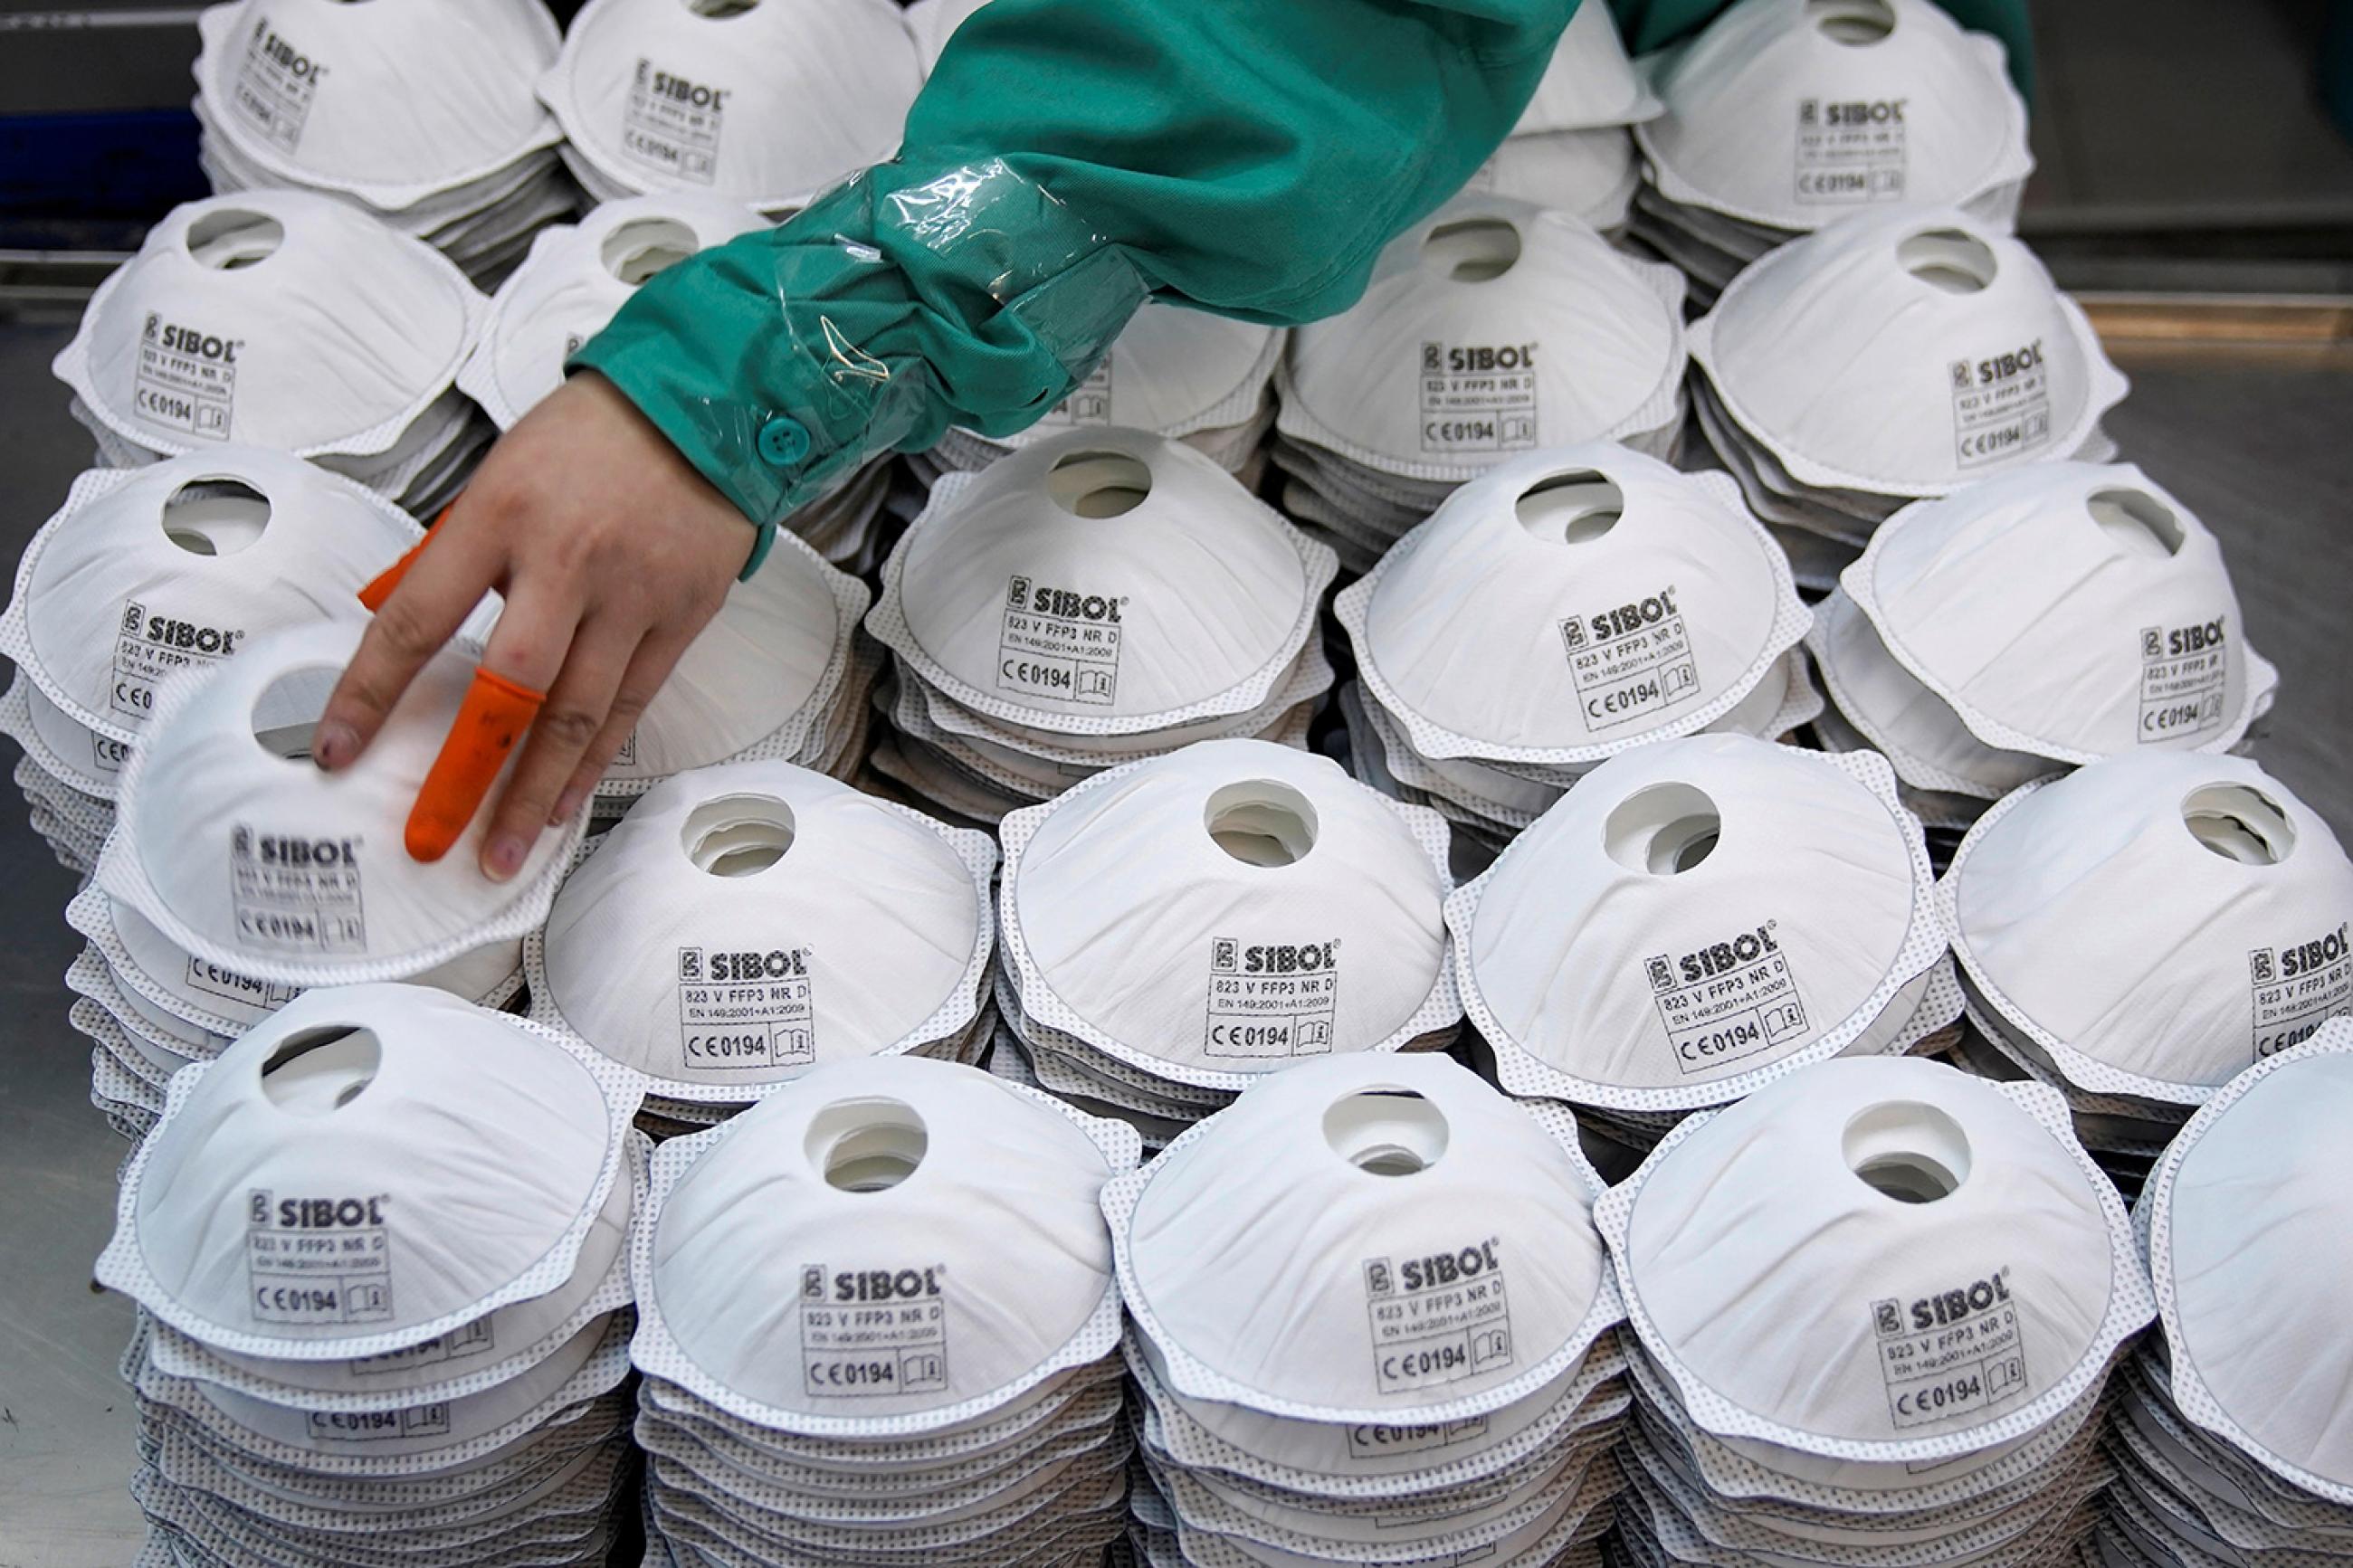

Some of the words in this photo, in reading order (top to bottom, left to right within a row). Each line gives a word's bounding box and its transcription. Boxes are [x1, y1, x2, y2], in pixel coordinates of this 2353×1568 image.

[653, 71, 721, 114] SIBOL
[1826, 101, 1903, 126] SIBOL
[162, 325, 235, 363] SIBOL
[1449, 346, 1532, 371] SIBOL
[1978, 344, 2043, 384] SIBOL
[1034, 588, 1121, 622] SIBOL
[1591, 591, 1677, 640] SIBOL
[148, 616, 234, 654] SIBOL
[1008, 616, 1027, 629] 823
[1033, 622, 1041, 632] V
[1046, 623, 1077, 640] FFP3
[1083, 629, 1101, 642] NR
[158, 652, 190, 668] FFP3
[1577, 655, 1597, 670] 823
[1602, 650, 1612, 660] V
[1617, 636, 1648, 657] FFP3
[1652, 629, 1670, 644] NR
[261, 836, 357, 868] SIBOL
[710, 949, 806, 980] SIBOL
[1245, 942, 1335, 973] SIBOL
[1680, 926, 1777, 982] SIBOL
[2282, 927, 2348, 975] SIBOL
[685, 991, 708, 1003] 823
[714, 991, 722, 1003] V
[729, 989, 764, 1003] FFP3
[770, 988, 791, 1000] NR
[797, 985, 806, 998] D
[1217, 980, 1239, 993] 823
[1247, 982, 1254, 993] V
[1262, 982, 1294, 994] FFP3
[1301, 980, 1319, 993] NR
[1326, 978, 1333, 991] D
[1664, 994, 1689, 1011] 823
[1692, 990, 1702, 1003] V
[1708, 977, 1744, 999] FFP3
[1748, 966, 1770, 984] NR
[1774, 960, 1784, 974] D
[689, 1008, 704, 1017] EN
[1672, 1012, 1690, 1025] EN
[279, 1195, 384, 1228] SIBOL
[1401, 1240, 1498, 1290] SIBOL
[835, 1267, 940, 1301] SIBOL
[1911, 1272, 2009, 1329] SIBOL
[1377, 1305, 1402, 1320] 823
[1408, 1301, 1418, 1316] V
[1426, 1292, 1462, 1313] FFP3
[1467, 1285, 1487, 1303] NR
[1887, 1344, 1914, 1360] 823
[1920, 1339, 1929, 1353] V
[1939, 1326, 1974, 1349] FFP3
[1979, 1317, 1999, 1336] NR
